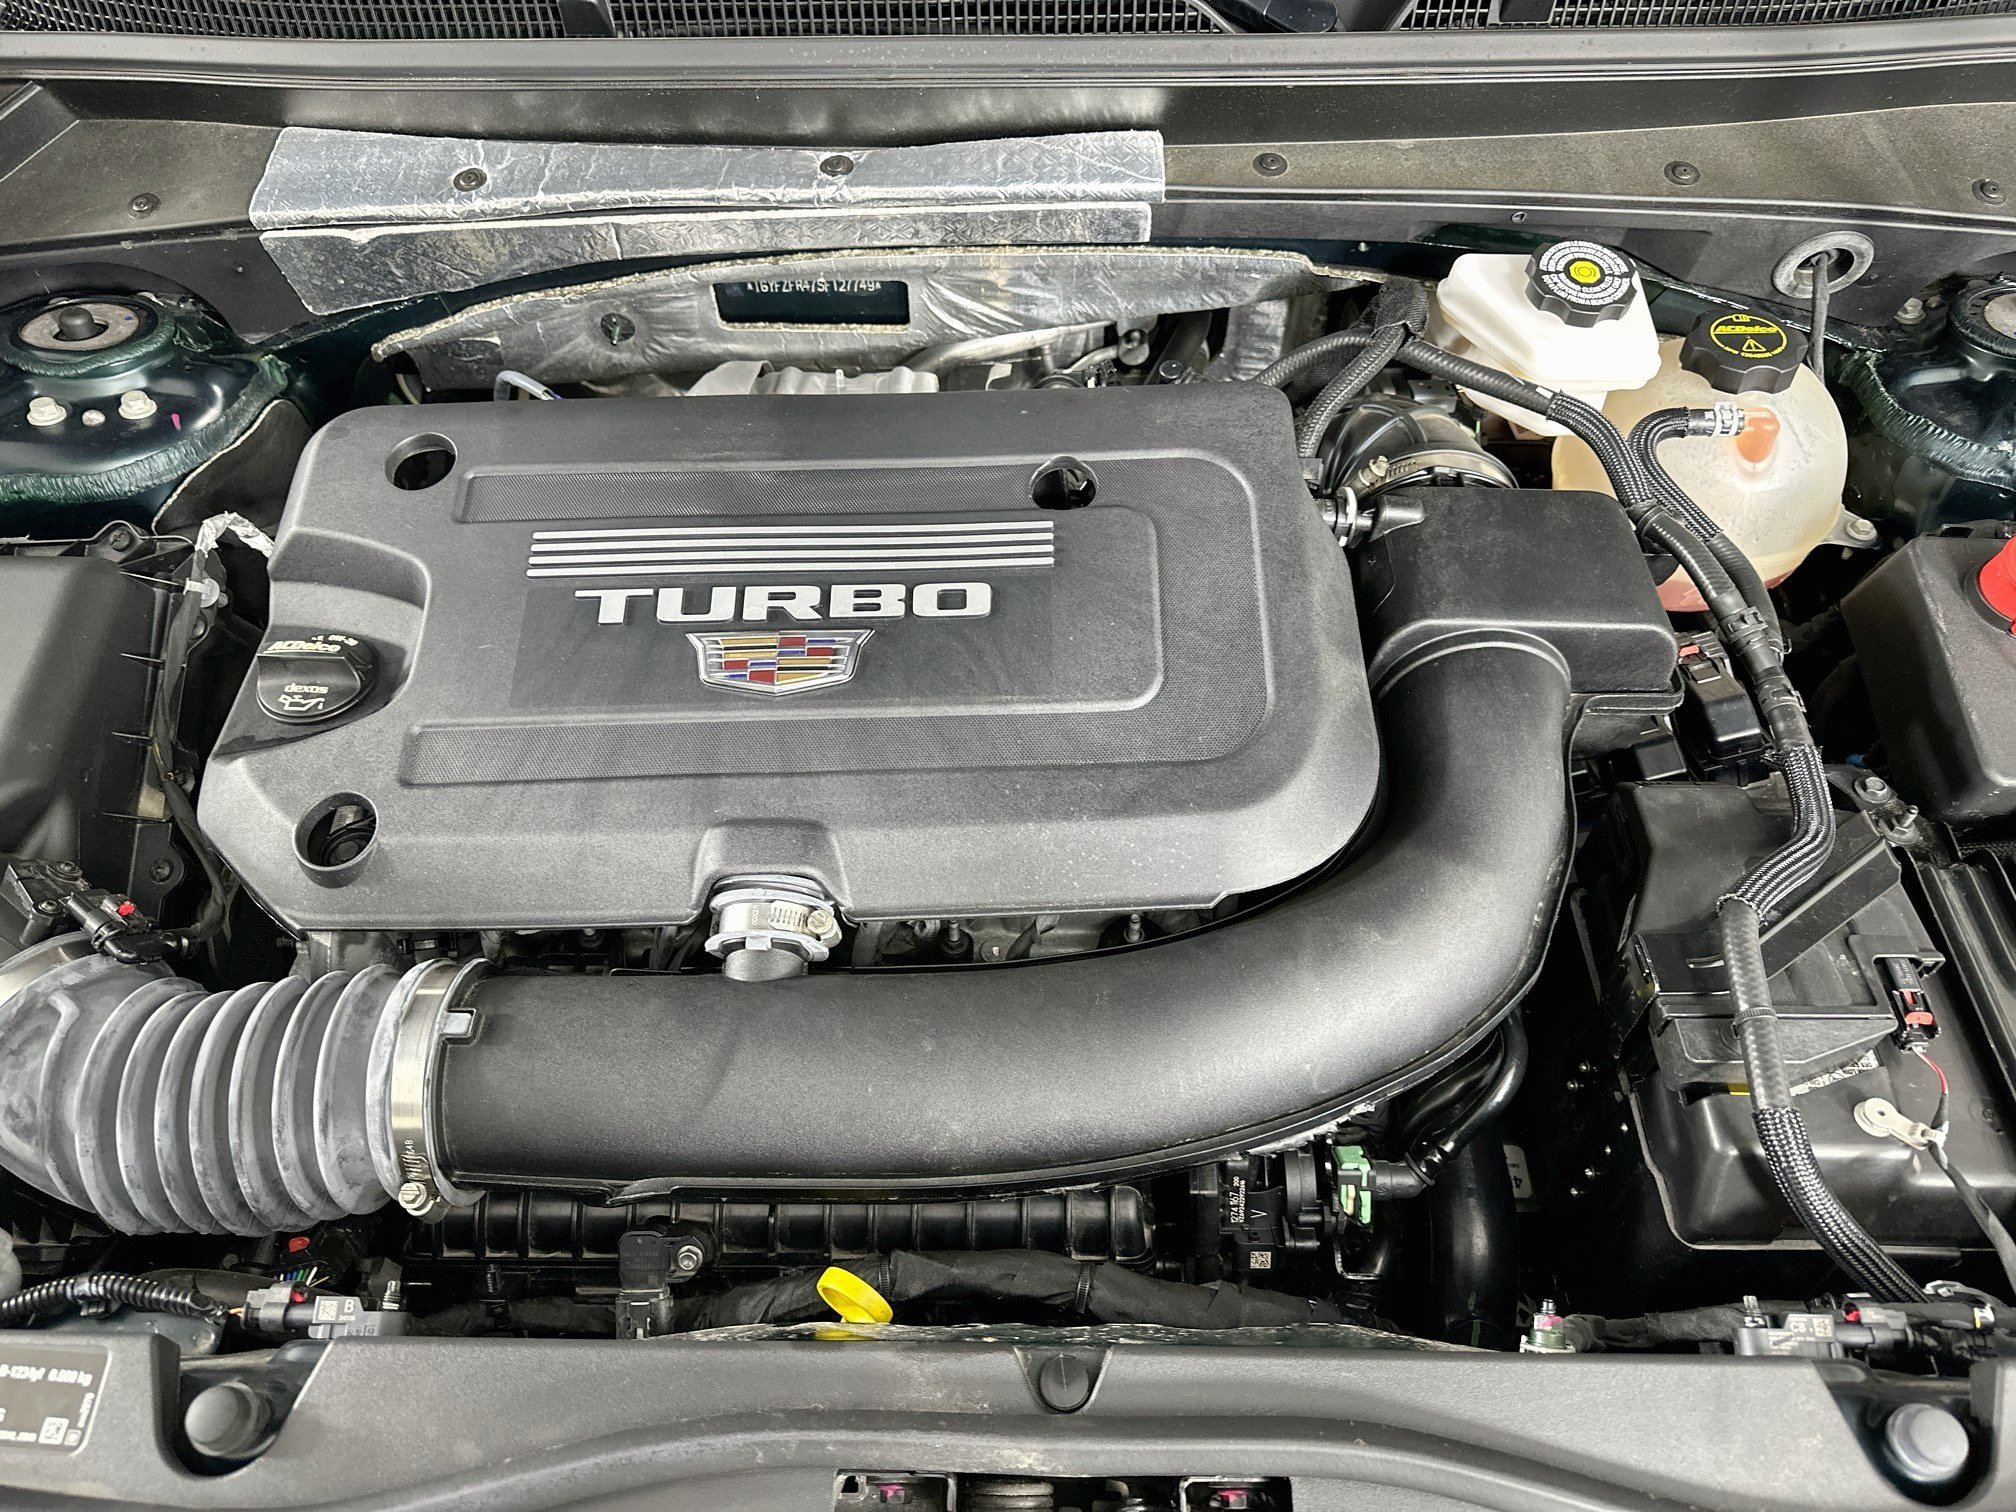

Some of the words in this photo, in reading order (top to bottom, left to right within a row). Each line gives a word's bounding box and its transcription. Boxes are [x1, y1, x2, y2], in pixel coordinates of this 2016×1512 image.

[1714, 325, 1778, 333] ACDelco
[574, 581, 993, 625] TURBO
[266, 640, 342, 653] ACDelco
[283, 682, 329, 694] dexos
[343, 1298, 355, 1314] B
